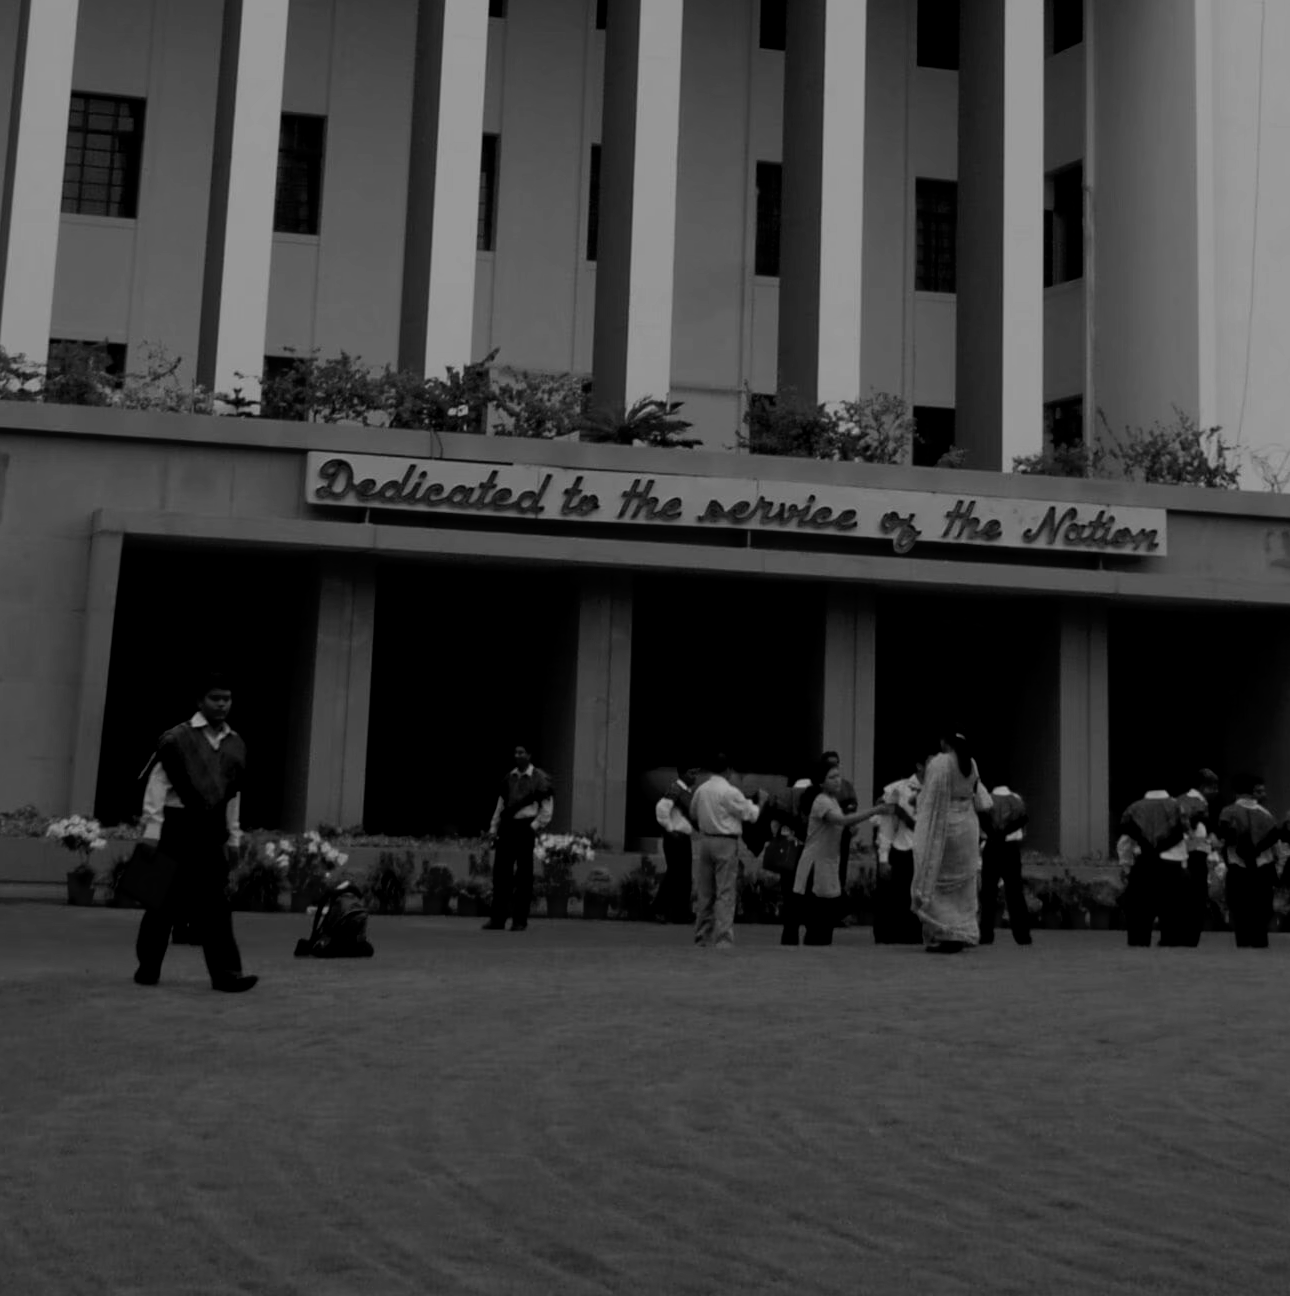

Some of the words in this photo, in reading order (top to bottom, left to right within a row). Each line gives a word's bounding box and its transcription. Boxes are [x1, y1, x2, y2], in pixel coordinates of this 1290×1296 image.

[315, 458, 553, 514] Dedicated
[561, 476, 601, 517] to
[616, 478, 683, 521] the
[697, 494, 859, 531] service
[880, 509, 923, 554] of
[940, 499, 1004, 542] the
[1023, 506, 1161, 553] Nation
